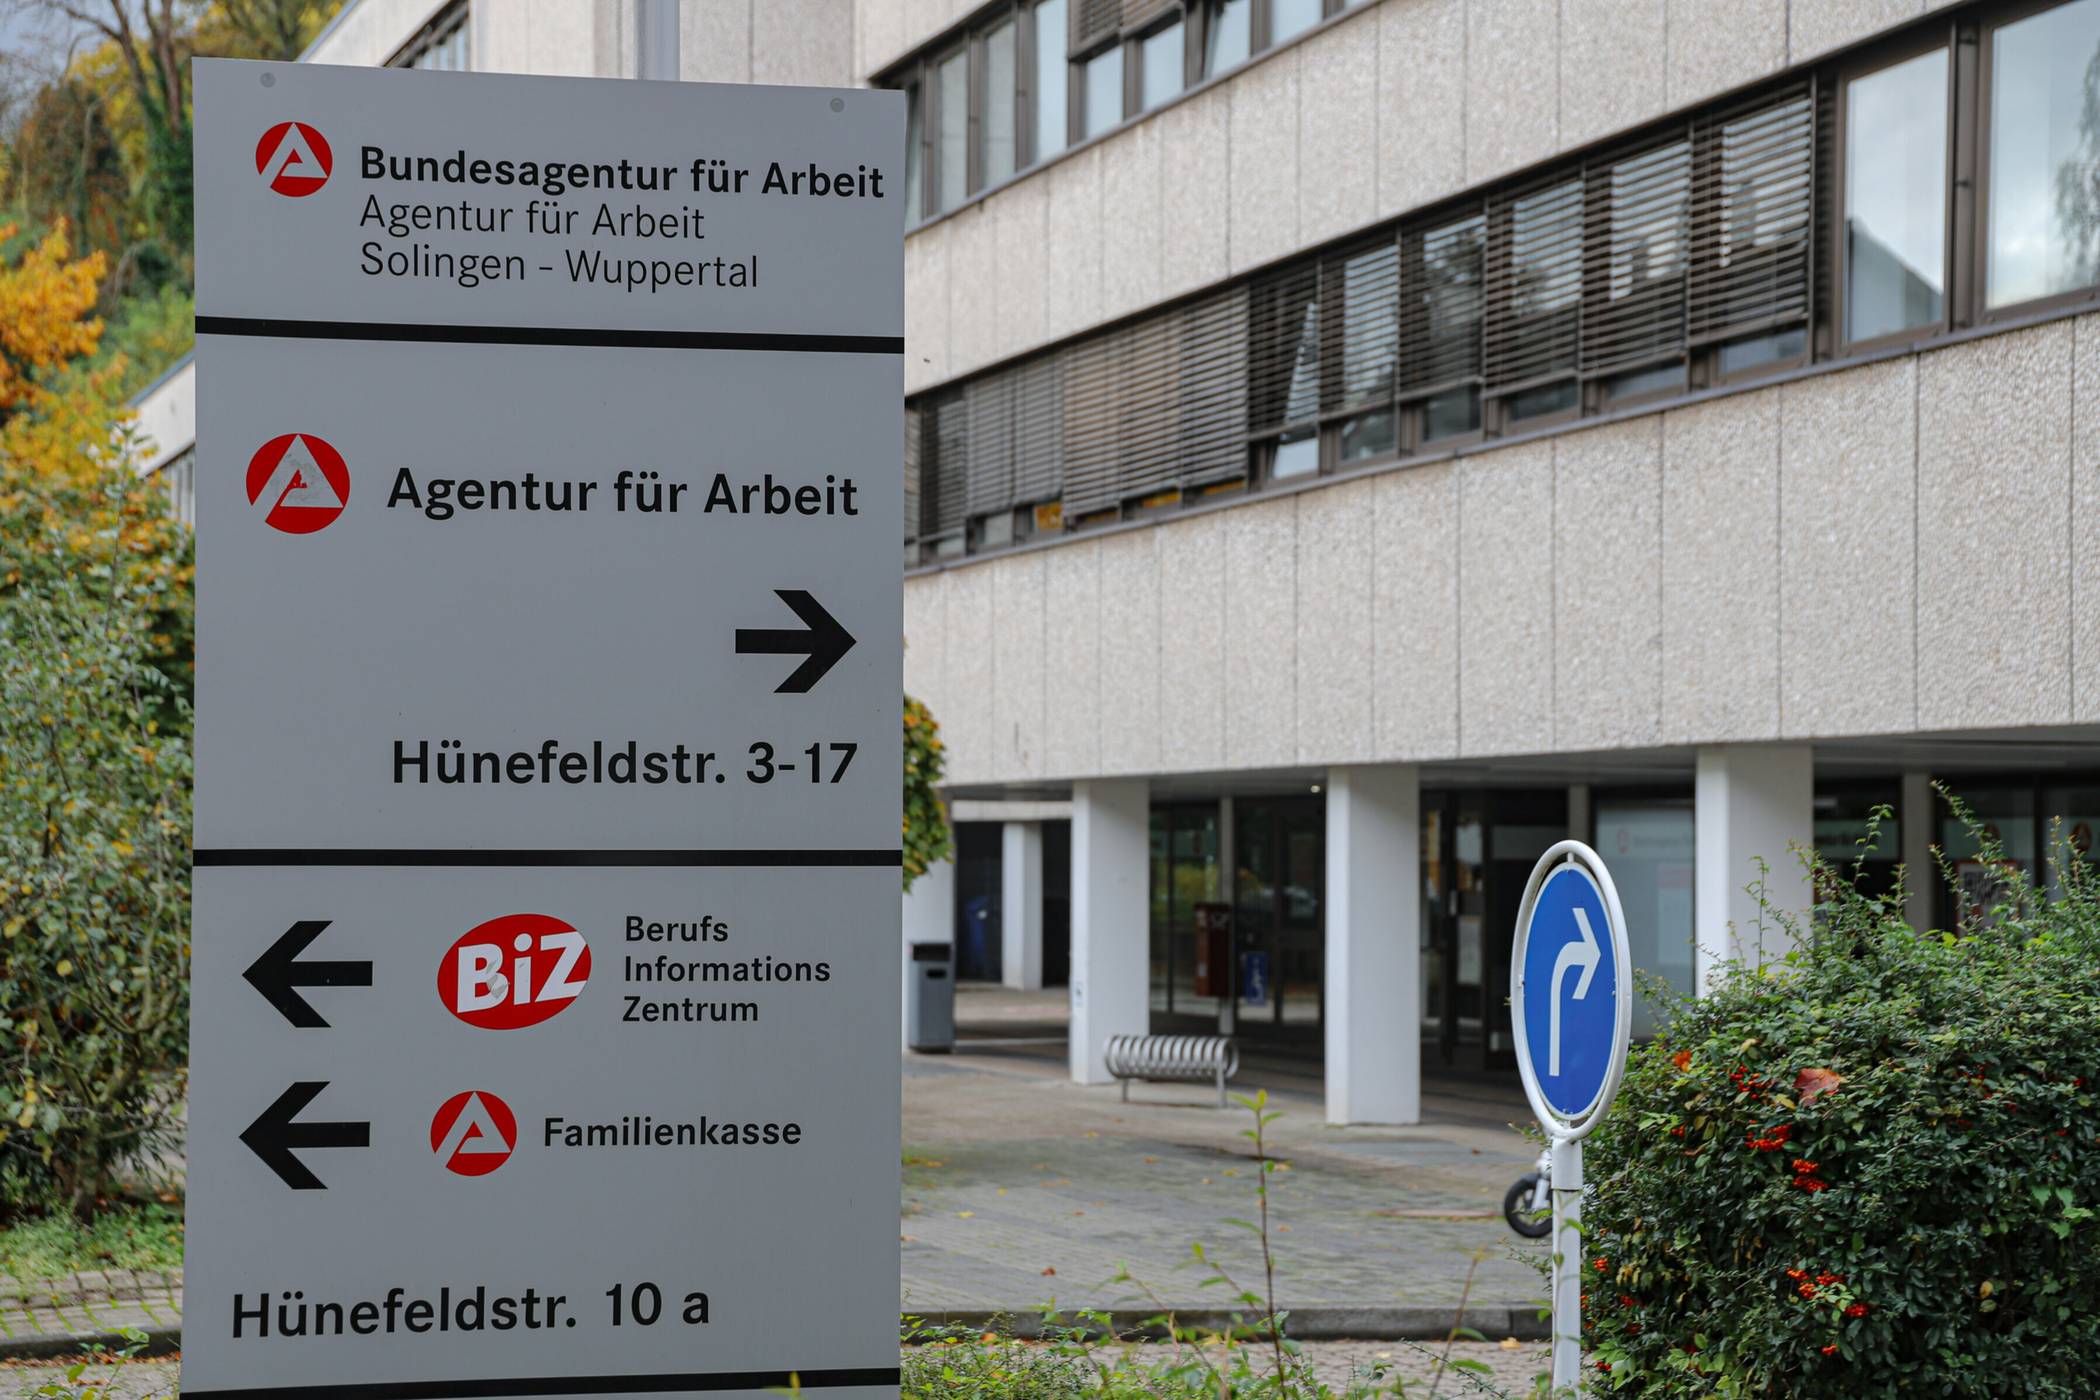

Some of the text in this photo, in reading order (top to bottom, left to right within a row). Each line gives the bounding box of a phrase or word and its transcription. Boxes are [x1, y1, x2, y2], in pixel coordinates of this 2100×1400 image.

[361, 145, 884, 199] Bundesagentur für Arbeit
[359, 194, 705, 240] Agentur für Arbeit
[360, 241, 525, 288] Solingen
[565, 249, 757, 294] Wuppertal
[386, 467, 859, 521] Agentur für Arbeit
[393, 739, 858, 785] Hünefeldstr. 3-17
[625, 915, 729, 943] Berufs
[457, 931, 587, 1013] BiZ
[624, 954, 831, 983] Informations
[622, 995, 759, 1023] Zentrum
[544, 1115, 802, 1147] Familienkasse
[232, 1281, 710, 1339] Hünefeldstr. 10 a
